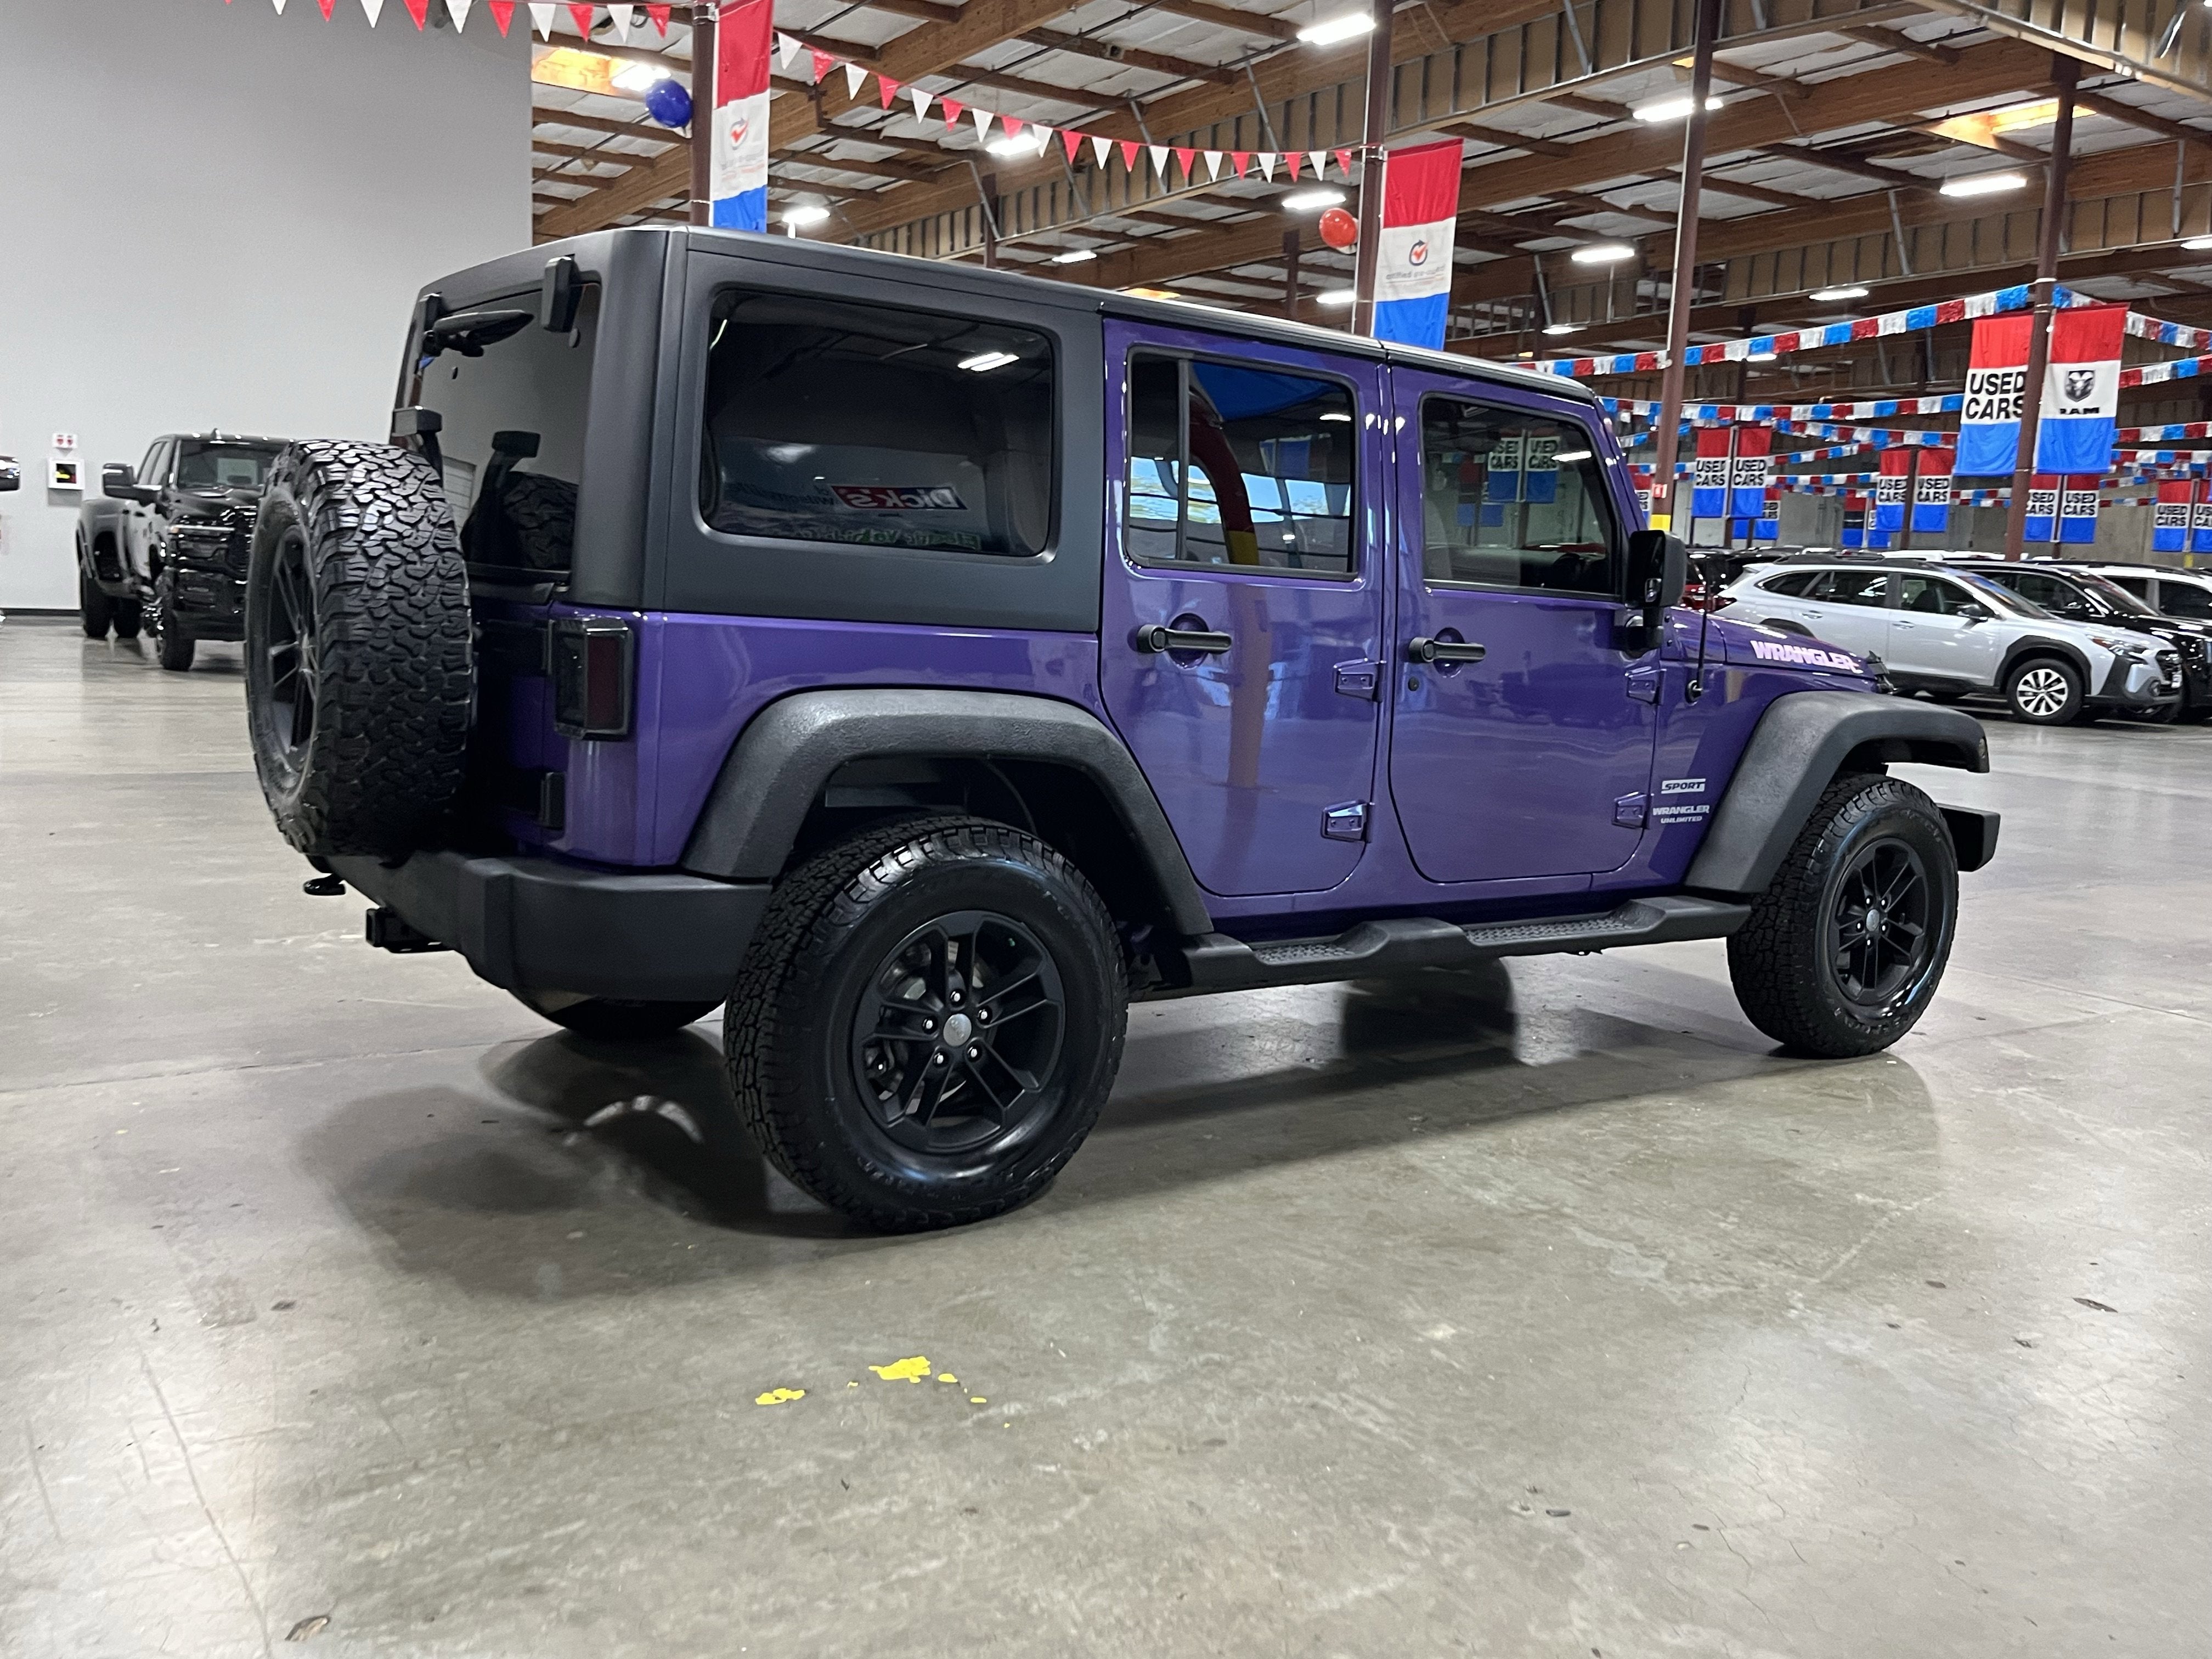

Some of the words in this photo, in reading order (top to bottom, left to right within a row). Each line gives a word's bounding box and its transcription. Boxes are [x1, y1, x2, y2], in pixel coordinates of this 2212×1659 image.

[1970, 371, 2026, 395] USED
[1966, 396, 2024, 419] CARS
[1696, 460, 1725, 472] USED
[1735, 459, 1766, 472] USED
[1696, 474, 1725, 486] CARS
[1733, 473, 1764, 486] CARS
[1918, 478, 1949, 489] USED
[1917, 491, 1948, 502] CARS
[2032, 493, 2055, 503] SED
[2066, 493, 2096, 503] USED
[2029, 504, 2053, 515] ARS
[2064, 505, 2095, 515] CARS
[2158, 505, 2187, 515] USED
[2155, 516, 2186, 526] CARS
[1750, 640, 1864, 674] WRANGLER
[1663, 781, 1705, 792] SPORT
[1653, 805, 1710, 815] WRANGLER
